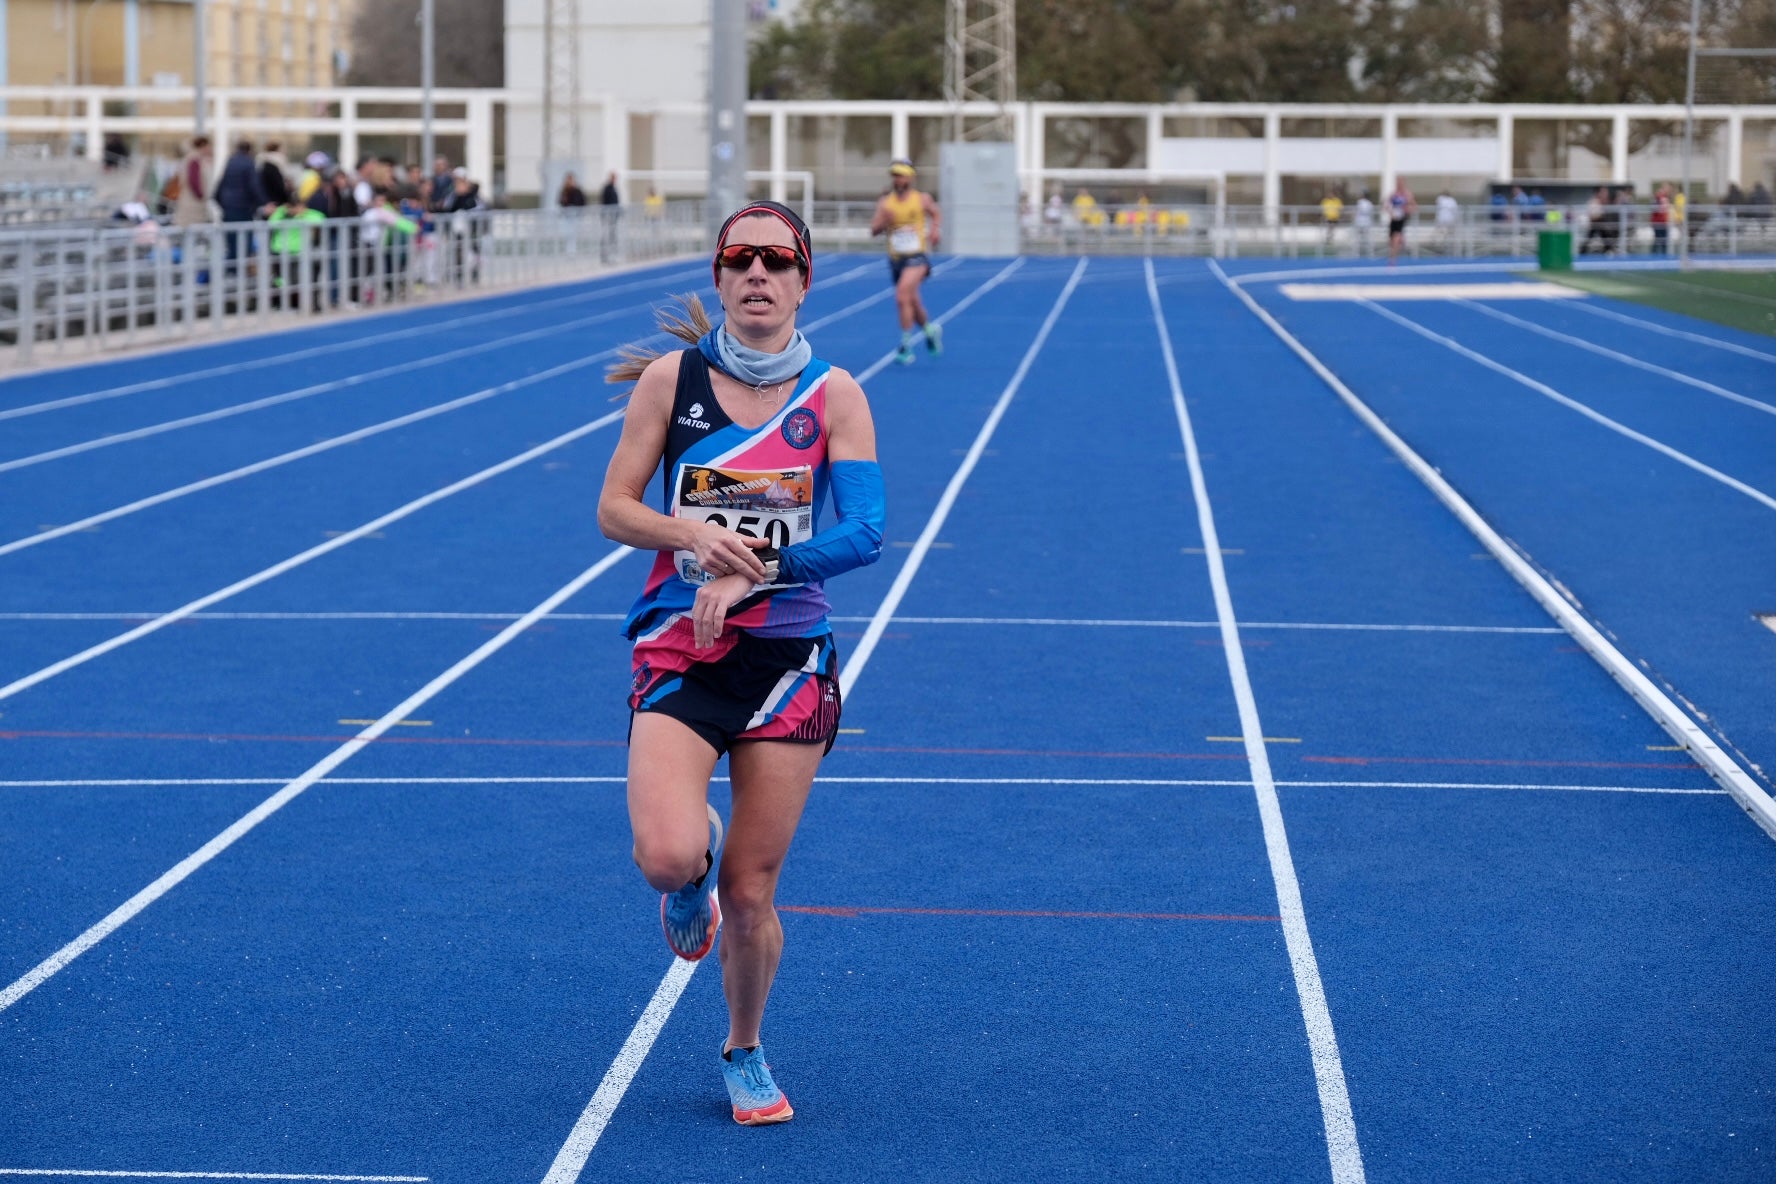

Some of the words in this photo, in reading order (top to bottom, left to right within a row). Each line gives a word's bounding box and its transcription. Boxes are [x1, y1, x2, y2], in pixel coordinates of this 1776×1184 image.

[678, 416, 710, 430] VIATOR
[685, 488, 723, 502] GRAN
[720, 477, 772, 495] PREMIO
